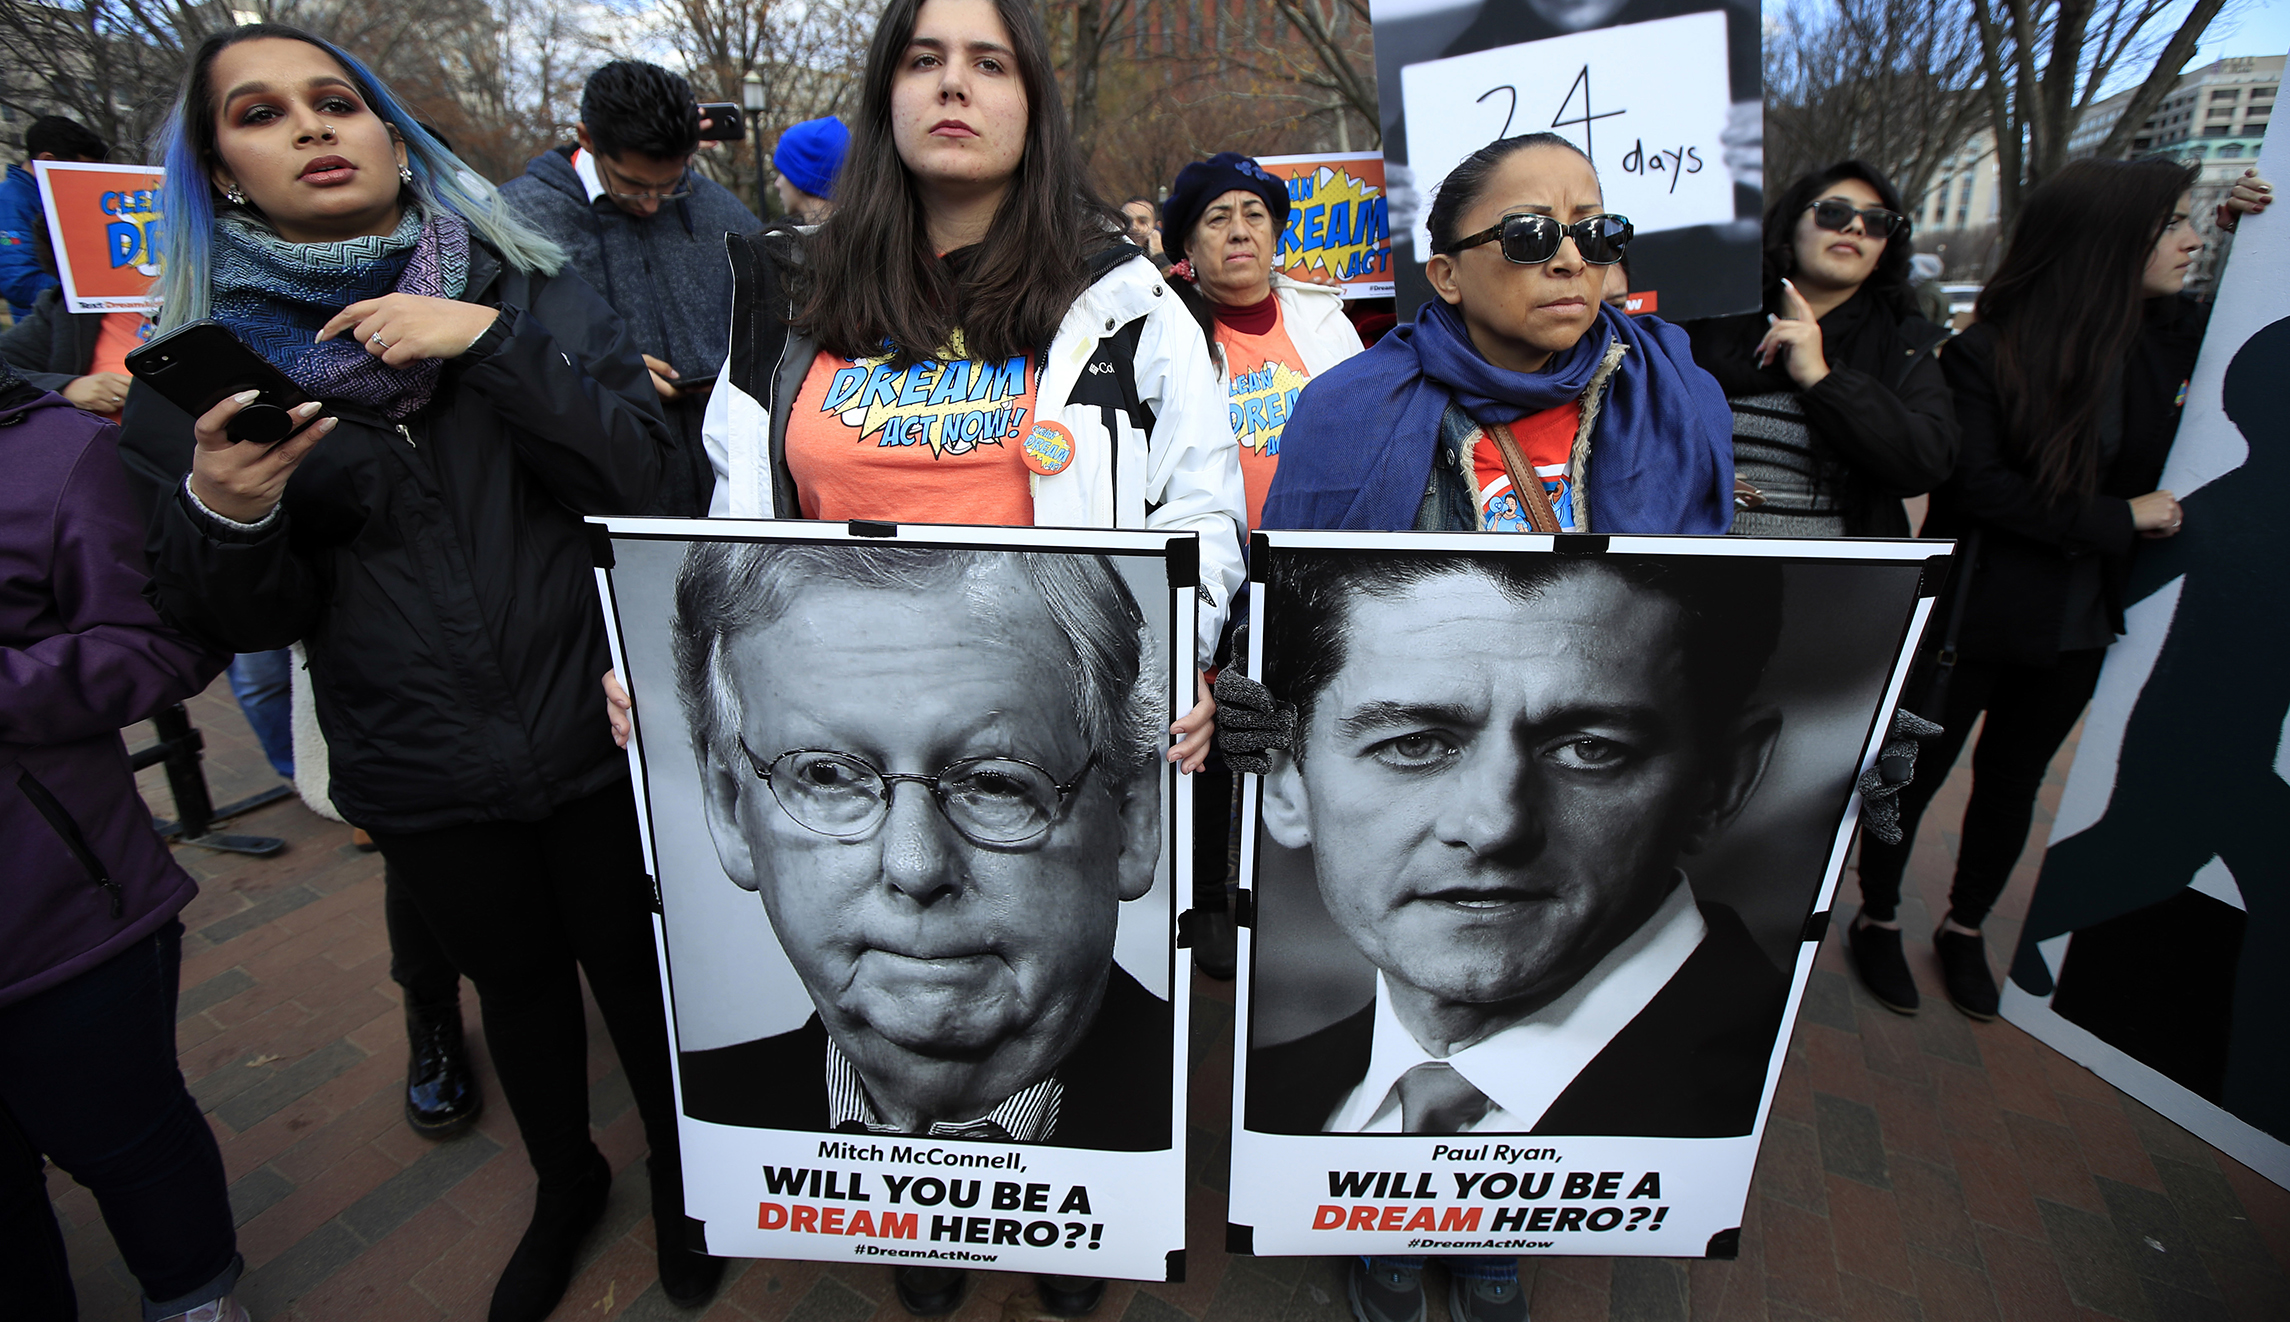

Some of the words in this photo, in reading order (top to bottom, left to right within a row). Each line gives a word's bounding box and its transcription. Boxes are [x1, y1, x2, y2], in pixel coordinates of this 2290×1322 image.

[1621, 137, 1704, 195] days
[1346, 247, 1392, 278] ACT
[821, 354, 1028, 413] DREAM
[877, 414, 934, 447] ACT
[940, 407, 1027, 443] NOW!
[1031, 424, 1057, 441] CLEAN
[1022, 433, 1071, 464] DREAM
[818, 1141, 884, 1163] Mitch
[890, 1145, 1028, 1174] McConnell,
[1432, 1144, 1489, 1162] Paul
[1493, 1144, 1563, 1165] Ryan,
[762, 1165, 870, 1202] WILL
[882, 1174, 982, 1209] YOU
[991, 1181, 1051, 1213] BE
[1057, 1185, 1092, 1215] A
[1328, 1170, 1438, 1199] WILL
[1453, 1172, 1555, 1200] YOU
[1560, 1171, 1625, 1200] BE
[1626, 1171, 1661, 1200] A
[757, 1201, 919, 1241] DREAM
[930, 1214, 1104, 1251] HERO?!
[1311, 1204, 1484, 1233] DREAM
[1489, 1206, 1670, 1233] HERO?!
[854, 1244, 998, 1263] #DreamActNow
[1407, 1238, 1554, 1249] #DreamActNow
